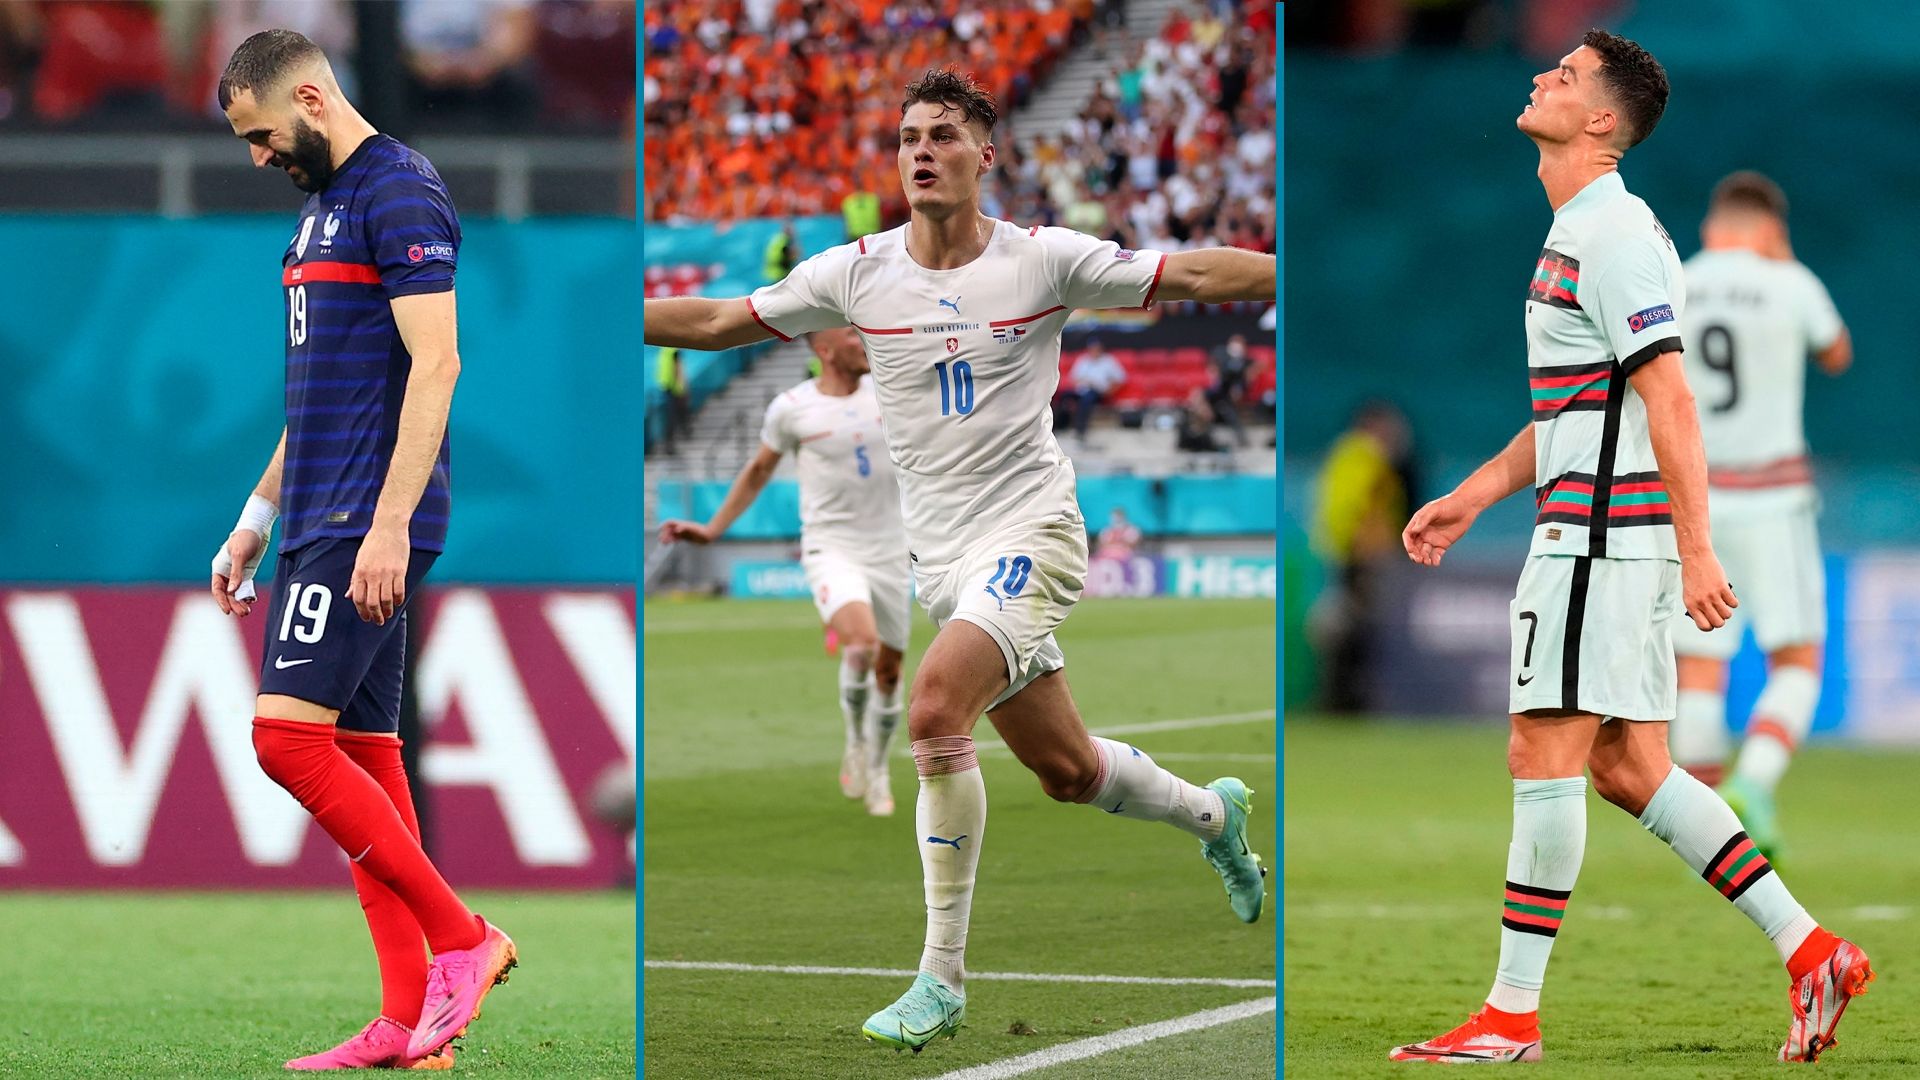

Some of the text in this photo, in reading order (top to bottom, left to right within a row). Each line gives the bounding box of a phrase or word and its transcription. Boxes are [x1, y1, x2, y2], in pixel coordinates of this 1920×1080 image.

[289, 284, 307, 347] 19
[934, 360, 974, 416] 10
[1699, 324, 1739, 413] 9
[854, 445, 871, 478] 5
[987, 555, 1032, 597] 10
[279, 582, 332, 643] 19
[1519, 611, 1538, 667] 7
